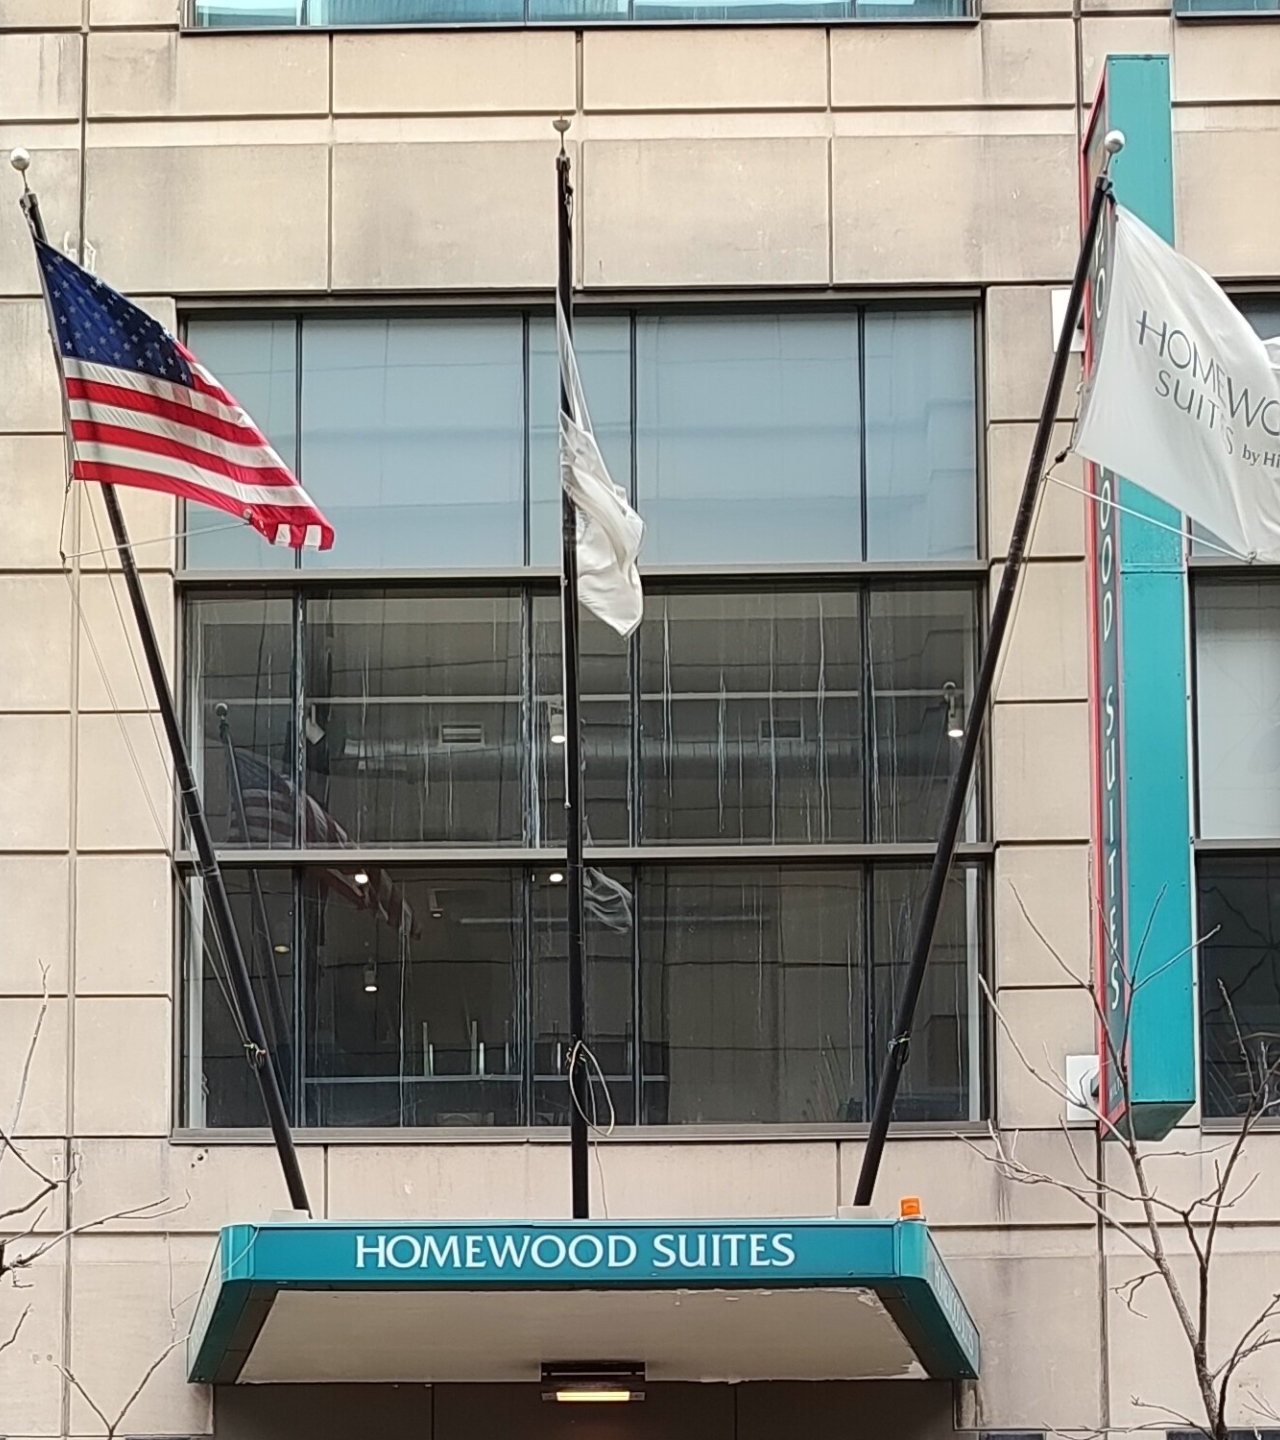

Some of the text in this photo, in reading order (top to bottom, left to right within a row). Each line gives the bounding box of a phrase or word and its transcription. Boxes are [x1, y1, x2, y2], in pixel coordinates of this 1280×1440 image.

[1155, 370, 1234, 456] SUITS
[1241, 443, 1261, 467] by
[1105, 685, 1120, 1011] SUITES
[355, 1233, 796, 1269] HOMEWOOD SUITES
